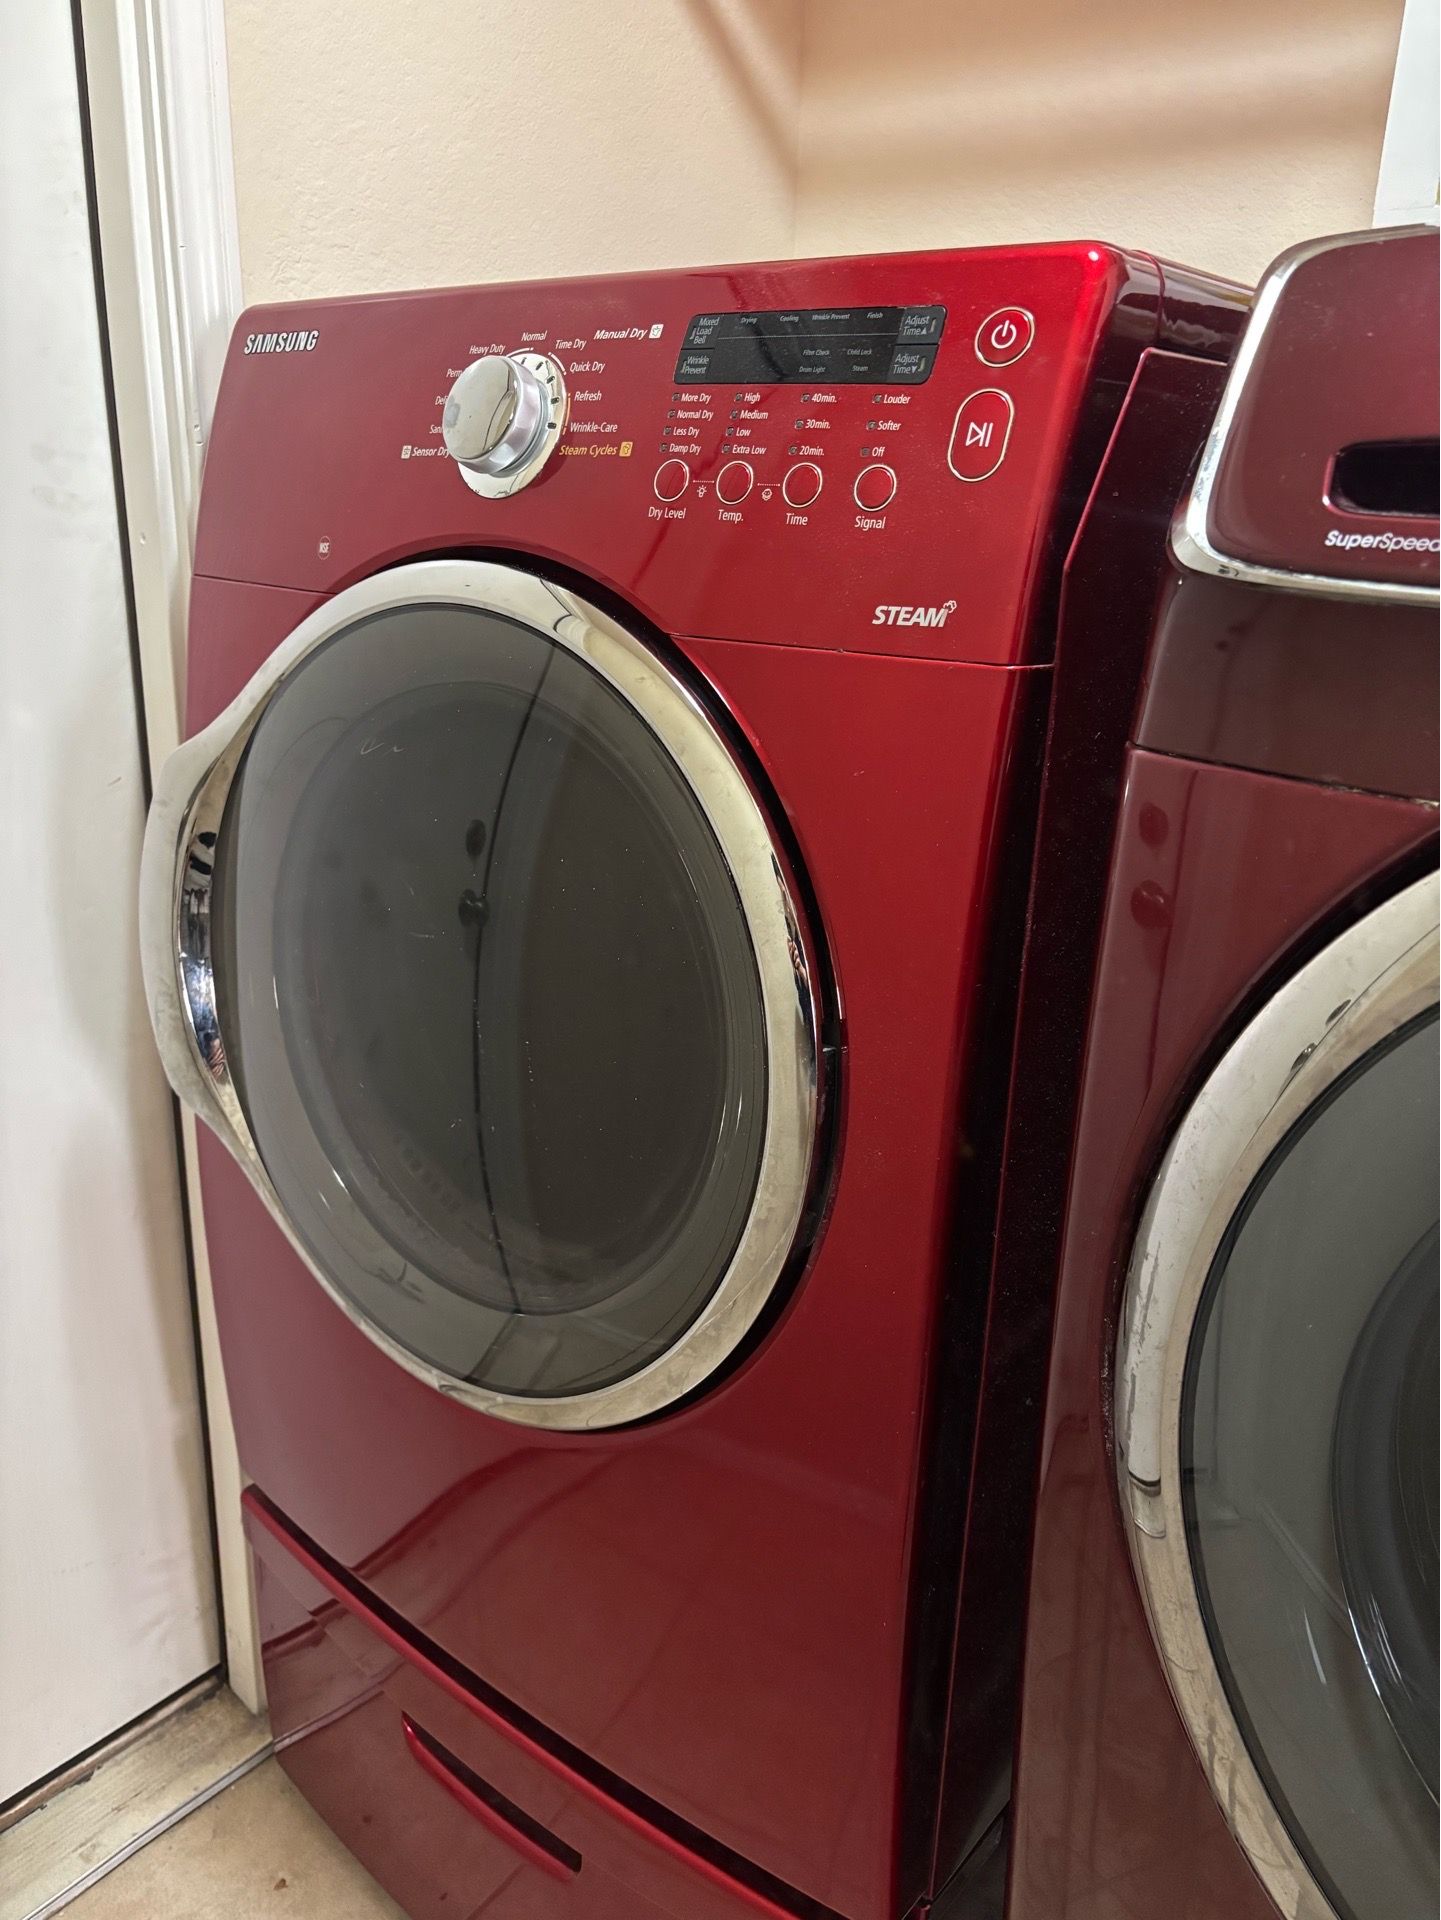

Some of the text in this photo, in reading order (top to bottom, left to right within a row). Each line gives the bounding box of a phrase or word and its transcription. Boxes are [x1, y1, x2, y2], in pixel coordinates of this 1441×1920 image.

[699, 317, 720, 326] Mixed
[905, 315, 930, 326] Adjust
[520, 330, 547, 341] Normal
[593, 327, 648, 341] Manual Dry
[696, 326, 713, 335] Load
[903, 326, 921, 335] Time
[243, 330, 319, 355] SAMSUNG
[555, 338, 587, 350] Time Dry
[693, 335, 707, 344] Bell
[469, 343, 505, 356] Heavy Duty
[687, 355, 710, 365] Wrinkle
[894, 353, 920, 365] Adjust
[569, 361, 605, 374] Quick Dry
[684, 366, 706, 375] Prevent
[892, 364, 911, 374] Time
[574, 390, 602, 401] Refresh
[680, 393, 711, 404] More Dry
[744, 392, 760, 404] High
[811, 392, 837, 403] 40min.
[883, 393, 911, 404] Louder
[676, 409, 714, 421] Normal Dry
[740, 409, 769, 420] Medium
[570, 421, 618, 433] Wrinkle-Care
[805, 419, 831, 429] 30min.
[877, 420, 901, 431] Softer
[673, 427, 700, 438] Less Dry
[736, 427, 751, 437] Low
[411, 446, 451, 459] Sensor Dry
[558, 443, 619, 458] Steam Cycles
[669, 443, 702, 456] Damp Dry
[732, 444, 767, 455] Extra Low
[799, 445, 825, 456] 20min.
[871, 446, 886, 457] Off
[648, 506, 687, 521] Dry Level
[717, 508, 744, 524] Temp.
[785, 513, 809, 526] Time
[854, 515, 887, 532] Signal
[871, 605, 949, 628] STEAM
